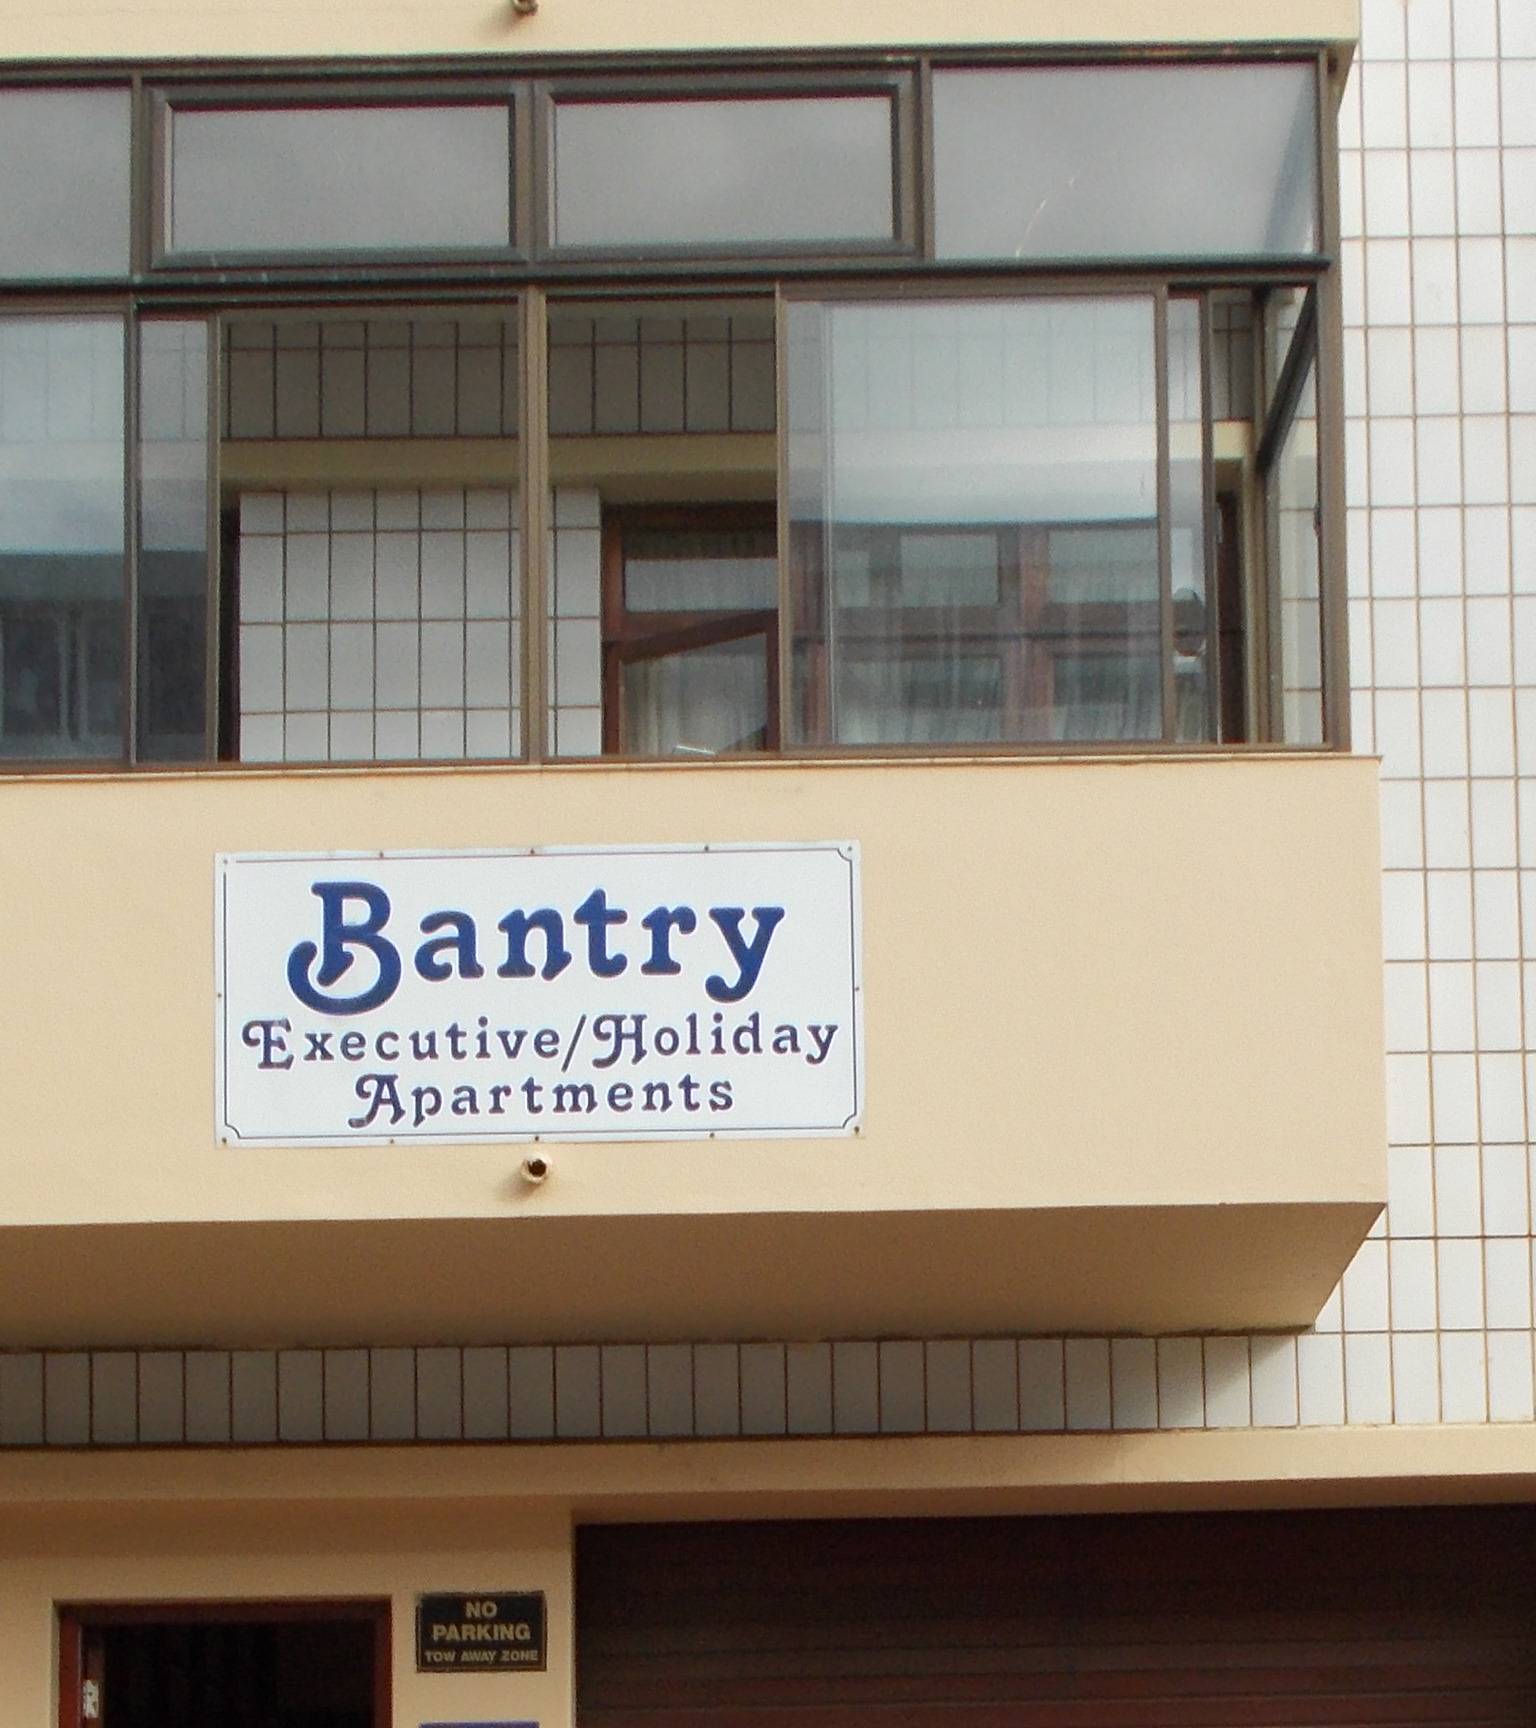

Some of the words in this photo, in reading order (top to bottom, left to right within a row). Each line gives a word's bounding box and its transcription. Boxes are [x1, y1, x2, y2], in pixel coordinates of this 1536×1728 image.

[287, 881, 785, 1016] Bantry
[241, 1011, 839, 1072] Executive/Holiday
[347, 1073, 735, 1128] Apartments
[465, 1601, 498, 1618] NO
[432, 1623, 531, 1642] PARKING
[424, 1650, 456, 1662] TOW
[460, 1650, 497, 1663] AWAY
[500, 1649, 538, 1662] ZONE
